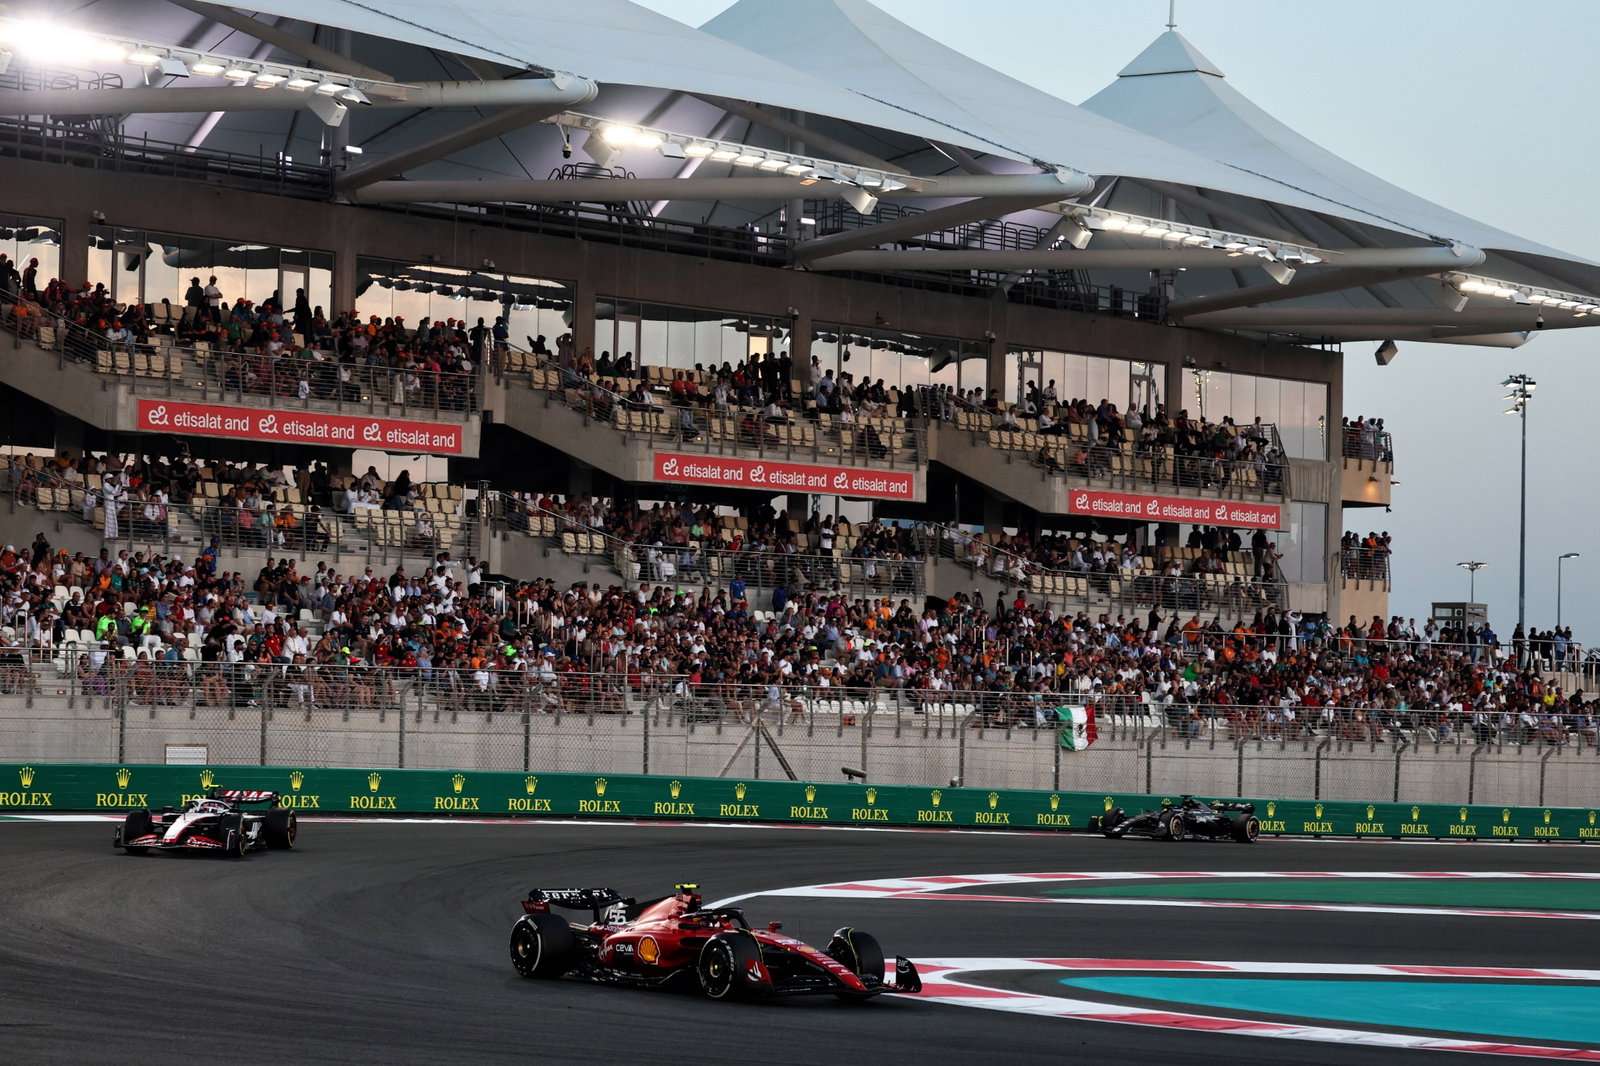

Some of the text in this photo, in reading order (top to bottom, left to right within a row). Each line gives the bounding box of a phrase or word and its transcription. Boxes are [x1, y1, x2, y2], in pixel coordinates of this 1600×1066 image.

[174, 412, 222, 430] etisalat
[225, 417, 250, 431] and
[283, 421, 329, 438] etisalat
[331, 425, 355, 440] and
[387, 429, 430, 446] etisalat
[432, 433, 455, 448] and
[683, 464, 722, 480] etisalat
[723, 467, 743, 481] and
[769, 471, 806, 486] etisalat
[808, 474, 827, 488] and
[852, 478, 888, 492] etisalat
[889, 480, 908, 494] and
[1092, 499, 1124, 513] etisalat
[1125, 502, 1142, 514] and
[1162, 505, 1193, 518] etisalat
[1194, 507, 1210, 520] and
[1230, 510, 1260, 523] etisalat
[1261, 512, 1277, 525] and
[0, 791, 52, 806] ROLEX
[96, 793, 148, 807] ROLEX
[350, 796, 397, 809] ROLEX
[434, 797, 480, 810] ROLEX
[508, 798, 551, 811] ROLEX
[579, 799, 621, 812] ROLEX
[654, 802, 695, 815] ROLEX
[719, 804, 759, 817] ROLEX
[790, 806, 829, 819] ROLEX
[852, 808, 889, 821] ROLEX
[917, 810, 953, 822] ROLEX
[975, 811, 1010, 824] ROLEX
[1037, 813, 1071, 825] ROLEX
[1303, 821, 1333, 832] ROLEX
[1355, 823, 1384, 833] ROLEX
[1401, 824, 1429, 834] ROLEX
[1450, 826, 1476, 835] ROLEX
[1492, 826, 1519, 836] ROLEX
[1534, 827, 1560, 837] ROLEX
[1579, 828, 1600, 837] ROLE
[608, 909, 627, 925] 55
